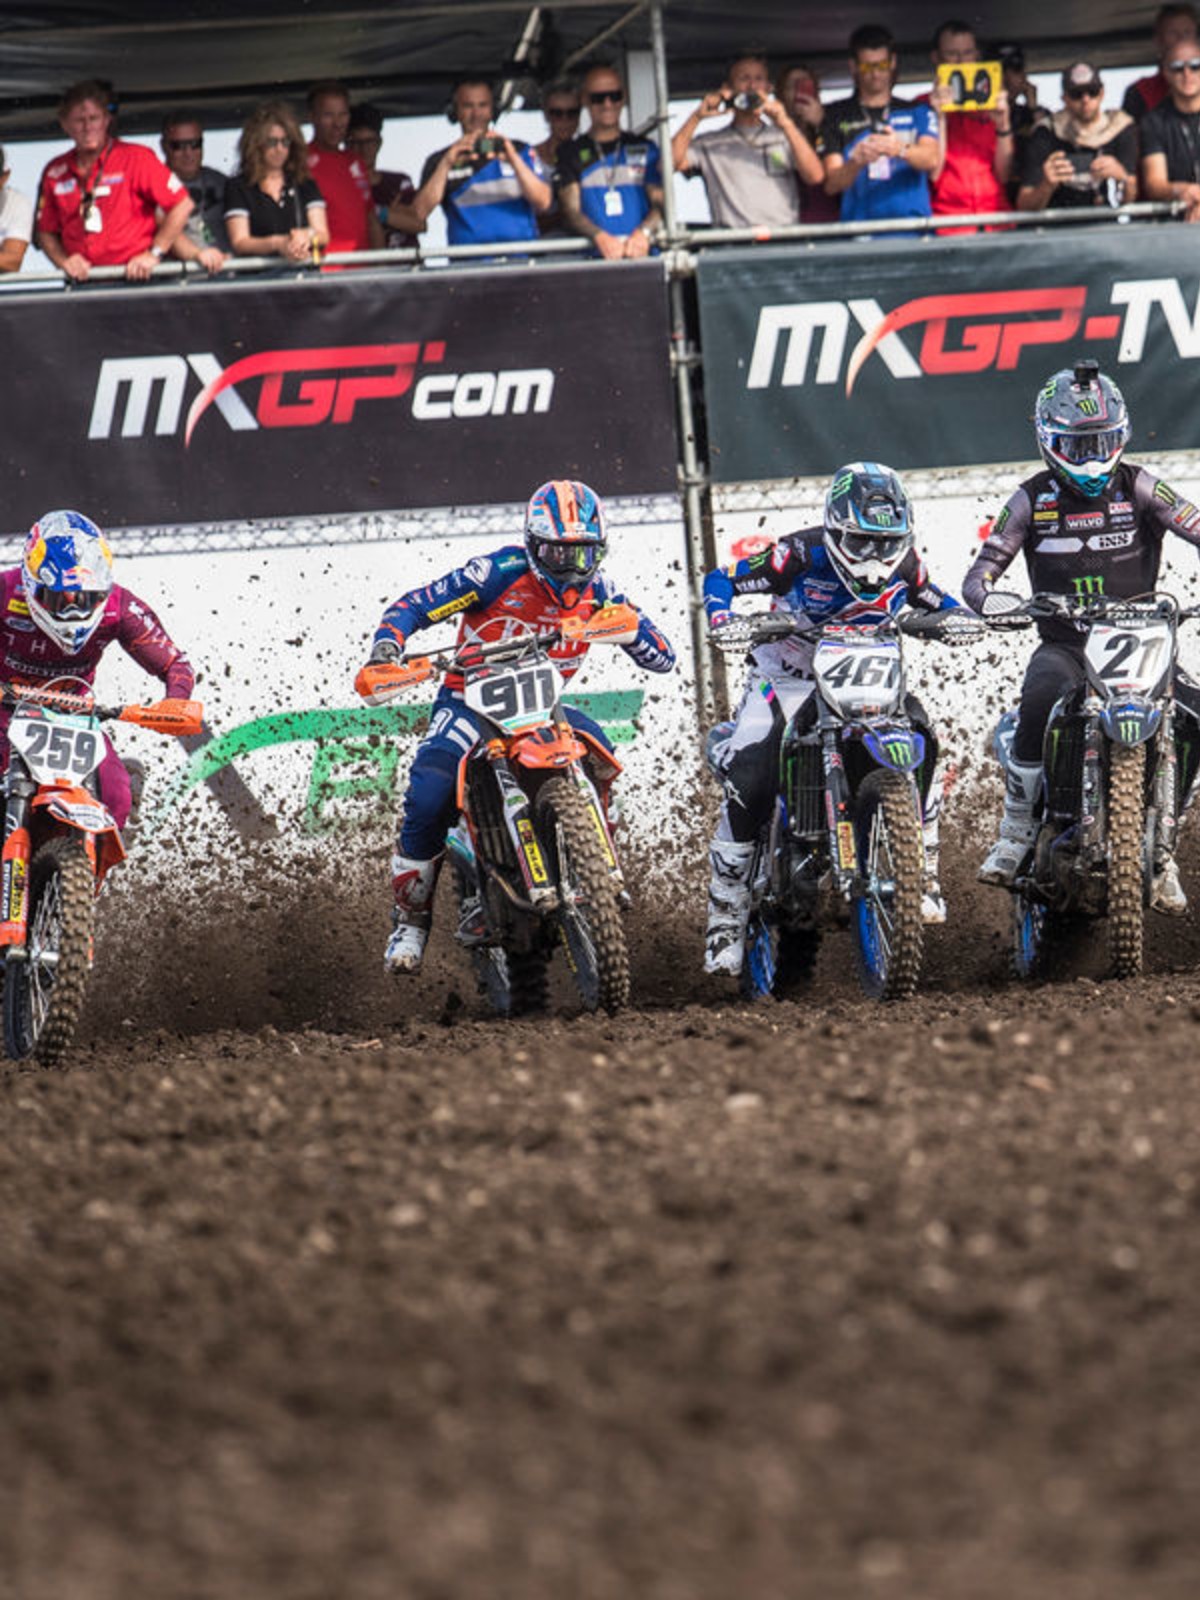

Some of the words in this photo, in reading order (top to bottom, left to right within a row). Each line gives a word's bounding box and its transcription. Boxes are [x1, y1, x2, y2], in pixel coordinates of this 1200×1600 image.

[1103, 633, 1166, 679] 21
[480, 669, 556, 721] 911
[24, 722, 97, 775] 259
